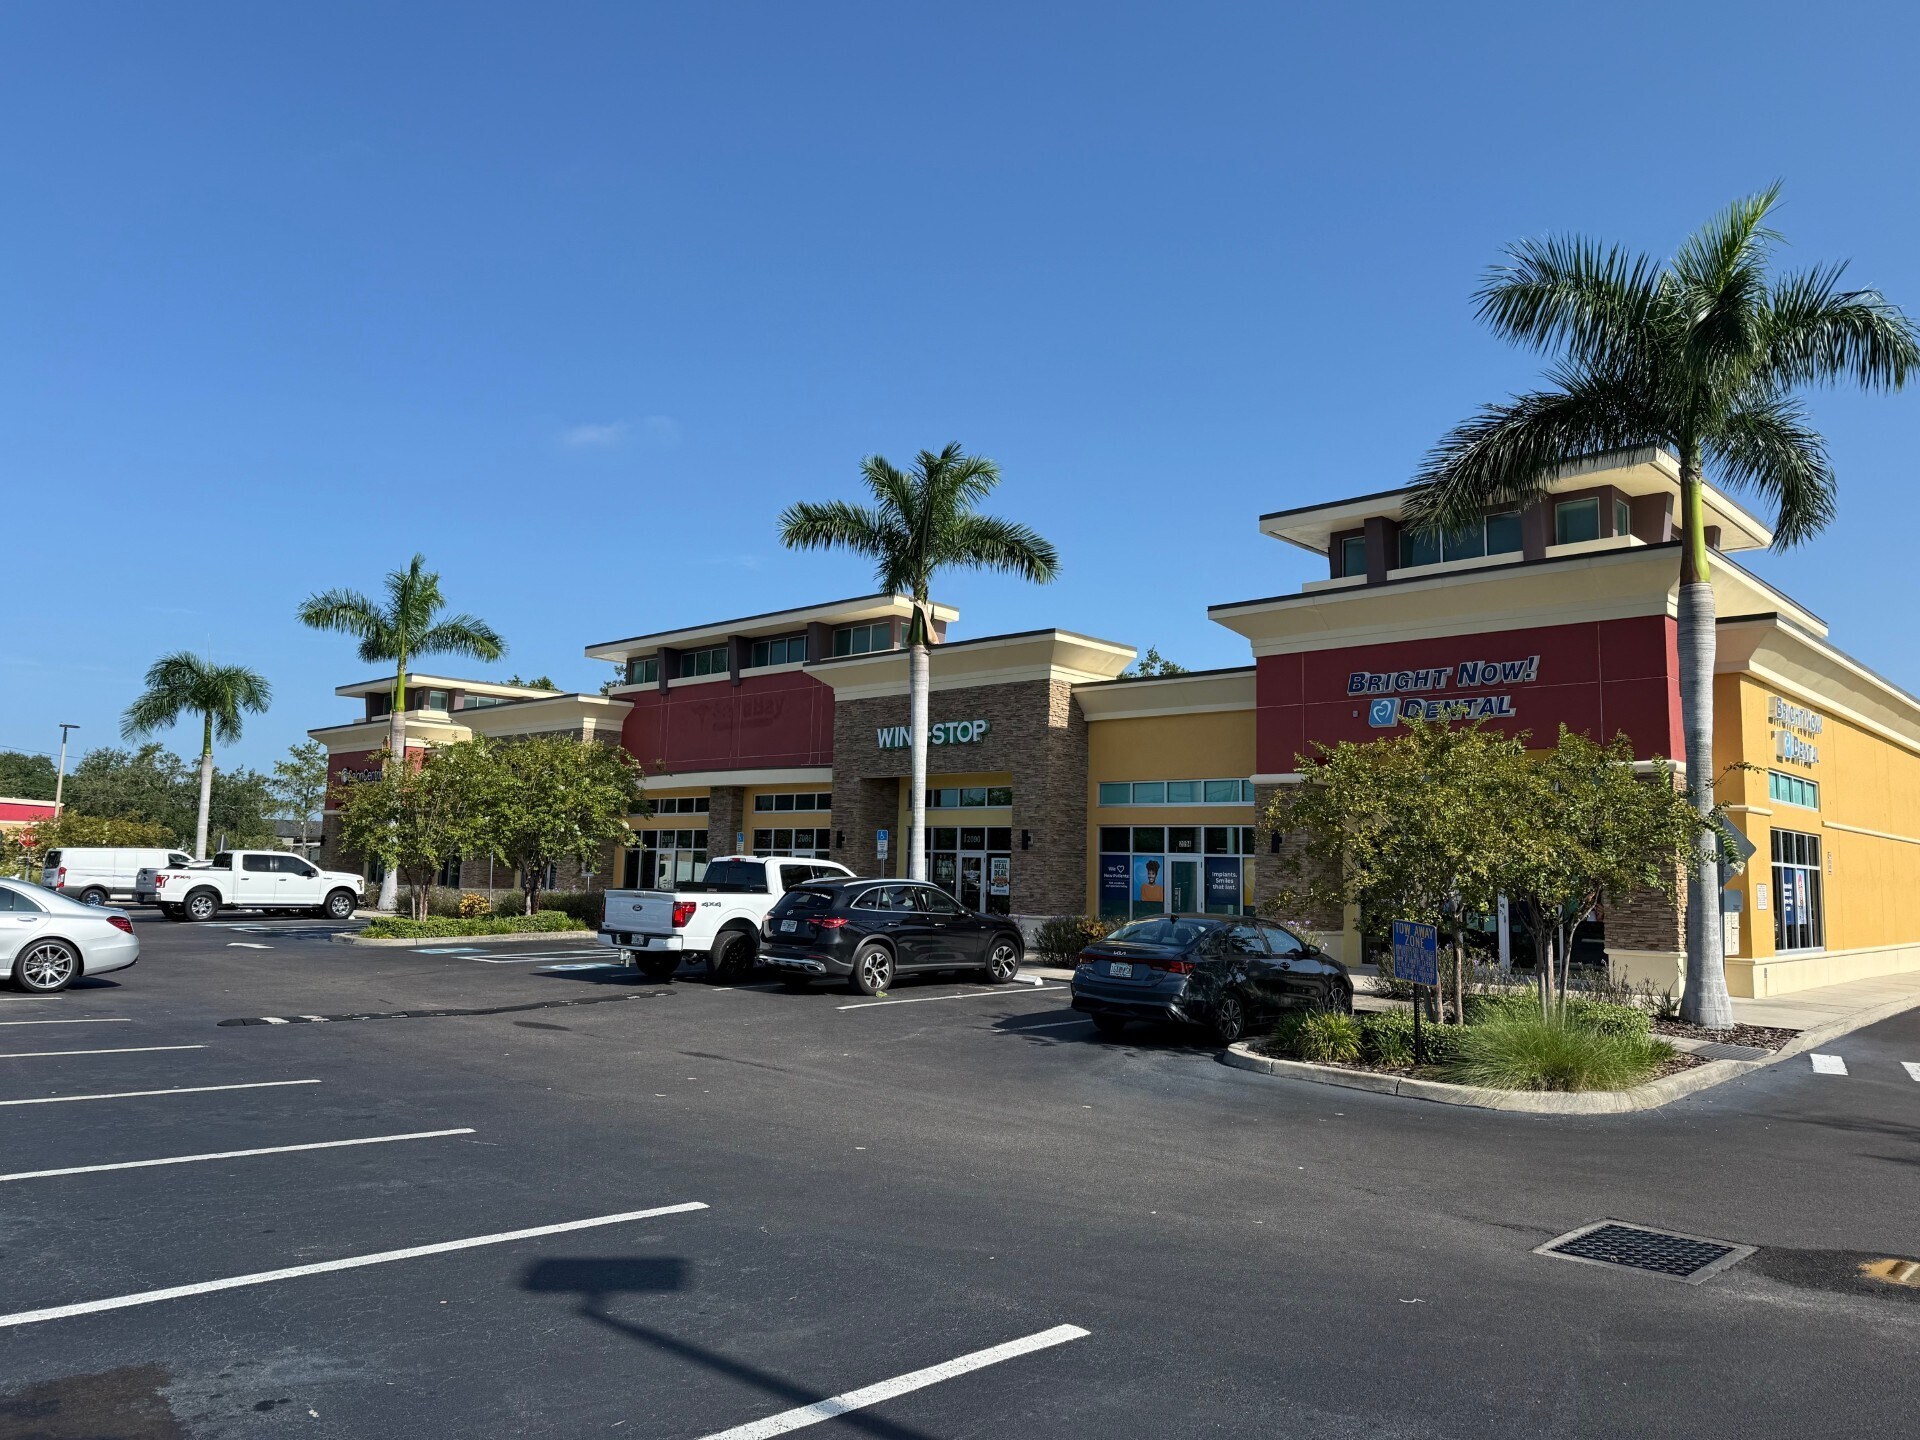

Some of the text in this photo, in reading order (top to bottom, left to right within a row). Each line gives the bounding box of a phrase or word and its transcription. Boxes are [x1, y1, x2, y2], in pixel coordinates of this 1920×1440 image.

[1348, 655, 1540, 696] BRIGHT NOW!
[1402, 695, 1516, 721] DENTAL
[877, 719, 988, 748] WINSTOP
[1395, 922, 1434, 940] TOW AWAY
[1404, 934, 1425, 949] ZONE
